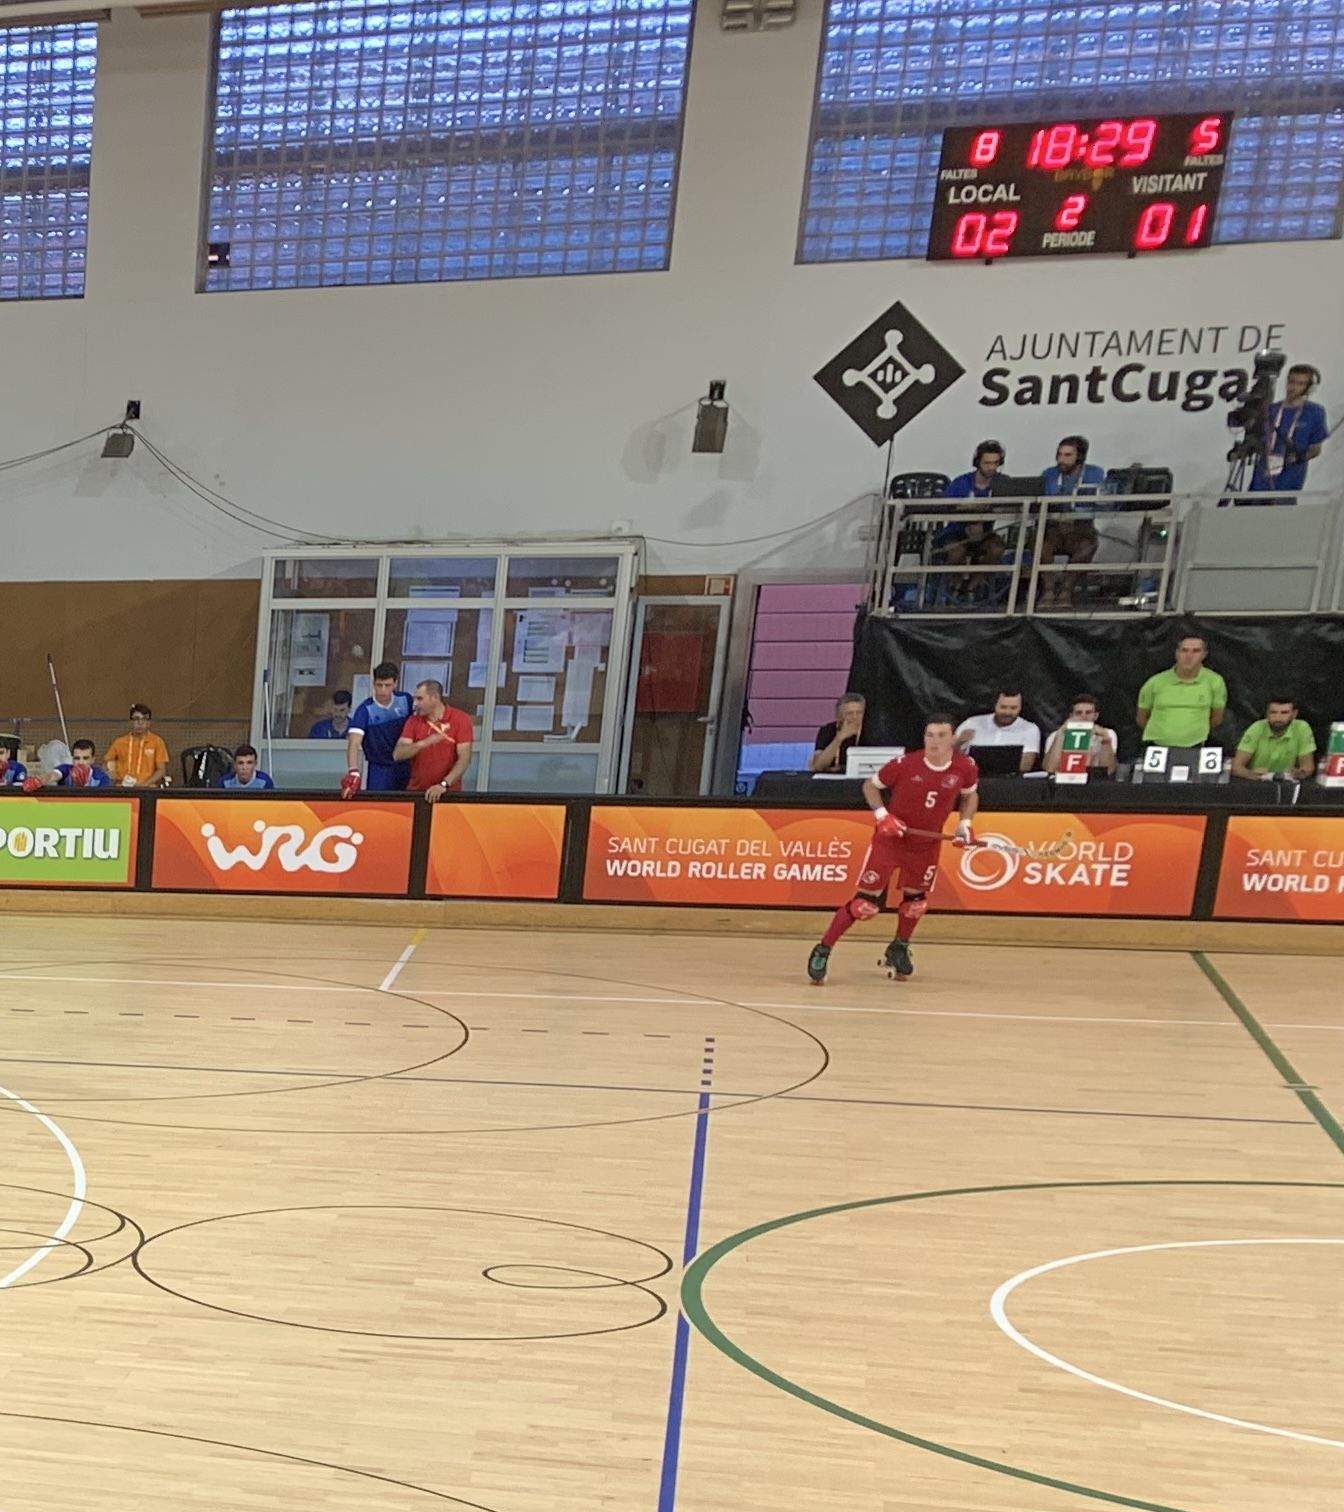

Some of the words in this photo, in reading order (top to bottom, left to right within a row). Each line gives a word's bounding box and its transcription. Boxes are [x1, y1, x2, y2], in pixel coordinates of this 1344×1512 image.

[972, 129, 1000, 164] 8
[1026, 119, 1158, 168] 18:29
[1191, 117, 1221, 155] 5
[948, 183, 1021, 205] LOCAL
[1132, 172, 1207, 194] VISITANT
[1057, 194, 1088, 230] 2
[952, 210, 1019, 256] 02
[1136, 202, 1207, 249] 01
[1042, 231, 1096, 248] PERIODE
[985, 326, 1229, 361] AJUNTAMENT
[1237, 323, 1286, 353] DE
[1071, 731, 1089, 749] T
[1066, 754, 1083, 772] F
[1149, 750, 1163, 768] 5
[923, 790, 939, 808] 5
[607, 836, 659, 855] SANT
[665, 838, 730, 857] CUGAT
[736, 839, 772, 857] DEL
[779, 836, 852, 859] VALLÈS
[1028, 841, 1135, 862] WORLD
[1246, 848, 1308, 867] SANT
[606, 859, 681, 878] WORLD
[688, 861, 766, 881] ROLLER
[773, 863, 848, 882] GAMES
[1023, 862, 1132, 887] SKATE
[1242, 873, 1330, 893] WORLD
